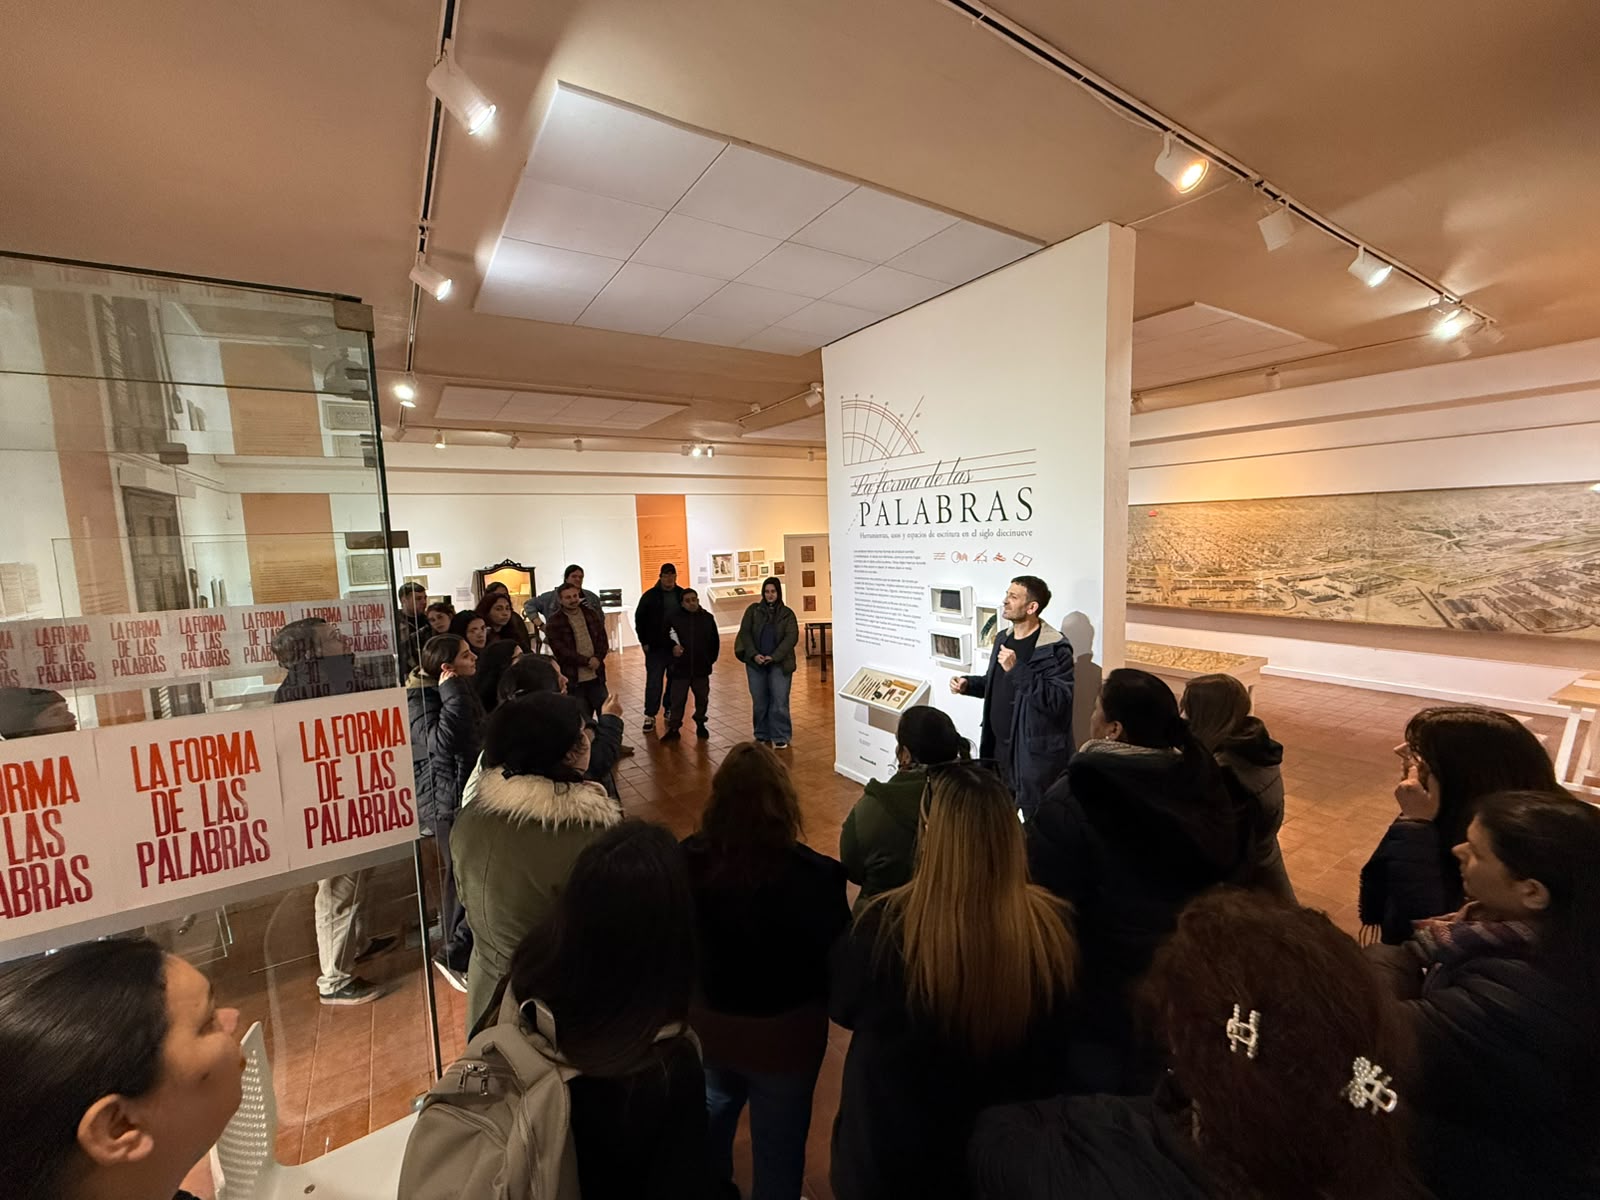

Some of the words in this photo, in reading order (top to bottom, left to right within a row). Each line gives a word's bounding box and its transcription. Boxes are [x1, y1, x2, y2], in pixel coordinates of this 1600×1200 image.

[872, 471, 920, 503] forma
[924, 460, 944, 488] de
[947, 456, 971, 486] las
[859, 486, 1033, 527] PALABRAS
[928, 529, 936, 538] de
[971, 528, 977, 537] el
[980, 528, 994, 540] siglo
[996, 528, 1033, 537] diecinueve
[242, 612, 255, 630] LA
[255, 610, 286, 628] FORMA
[347, 604, 358, 621] LA
[358, 603, 386, 620] FORMA
[109, 622, 125, 640] LA
[125, 619, 161, 639] FORMA
[179, 616, 192, 634] LA
[192, 614, 226, 633] FORMA
[352, 620, 363, 637] DE
[366, 619, 381, 636] LAS
[35, 627, 51, 647] LA
[186, 634, 199, 652] DE
[203, 632, 222, 650] LAS
[249, 629, 261, 646] DE
[348, 634, 389, 652] PALABRAS
[44, 646, 58, 665] DE
[117, 640, 130, 658] DE
[137, 638, 156, 657] LAS
[243, 645, 277, 664] PALAB
[112, 655, 168, 677] PALABRAS
[181, 649, 231, 670] PALABRAS
[299, 718, 329, 763] LA
[331, 707, 406, 756] FORMA
[130, 742, 168, 792] LA
[169, 730, 261, 785] FORMA
[0, 755, 80, 816] RMA
[315, 759, 344, 803] DE
[356, 750, 396, 796] LAS
[151, 787, 187, 838] DE
[200, 777, 250, 828] LAS
[304, 787, 414, 850] PALABRAS
[3, 809, 66, 866] LAS
[136, 818, 271, 889] PALABRAS
[0, 854, 94, 920] ABRAS
